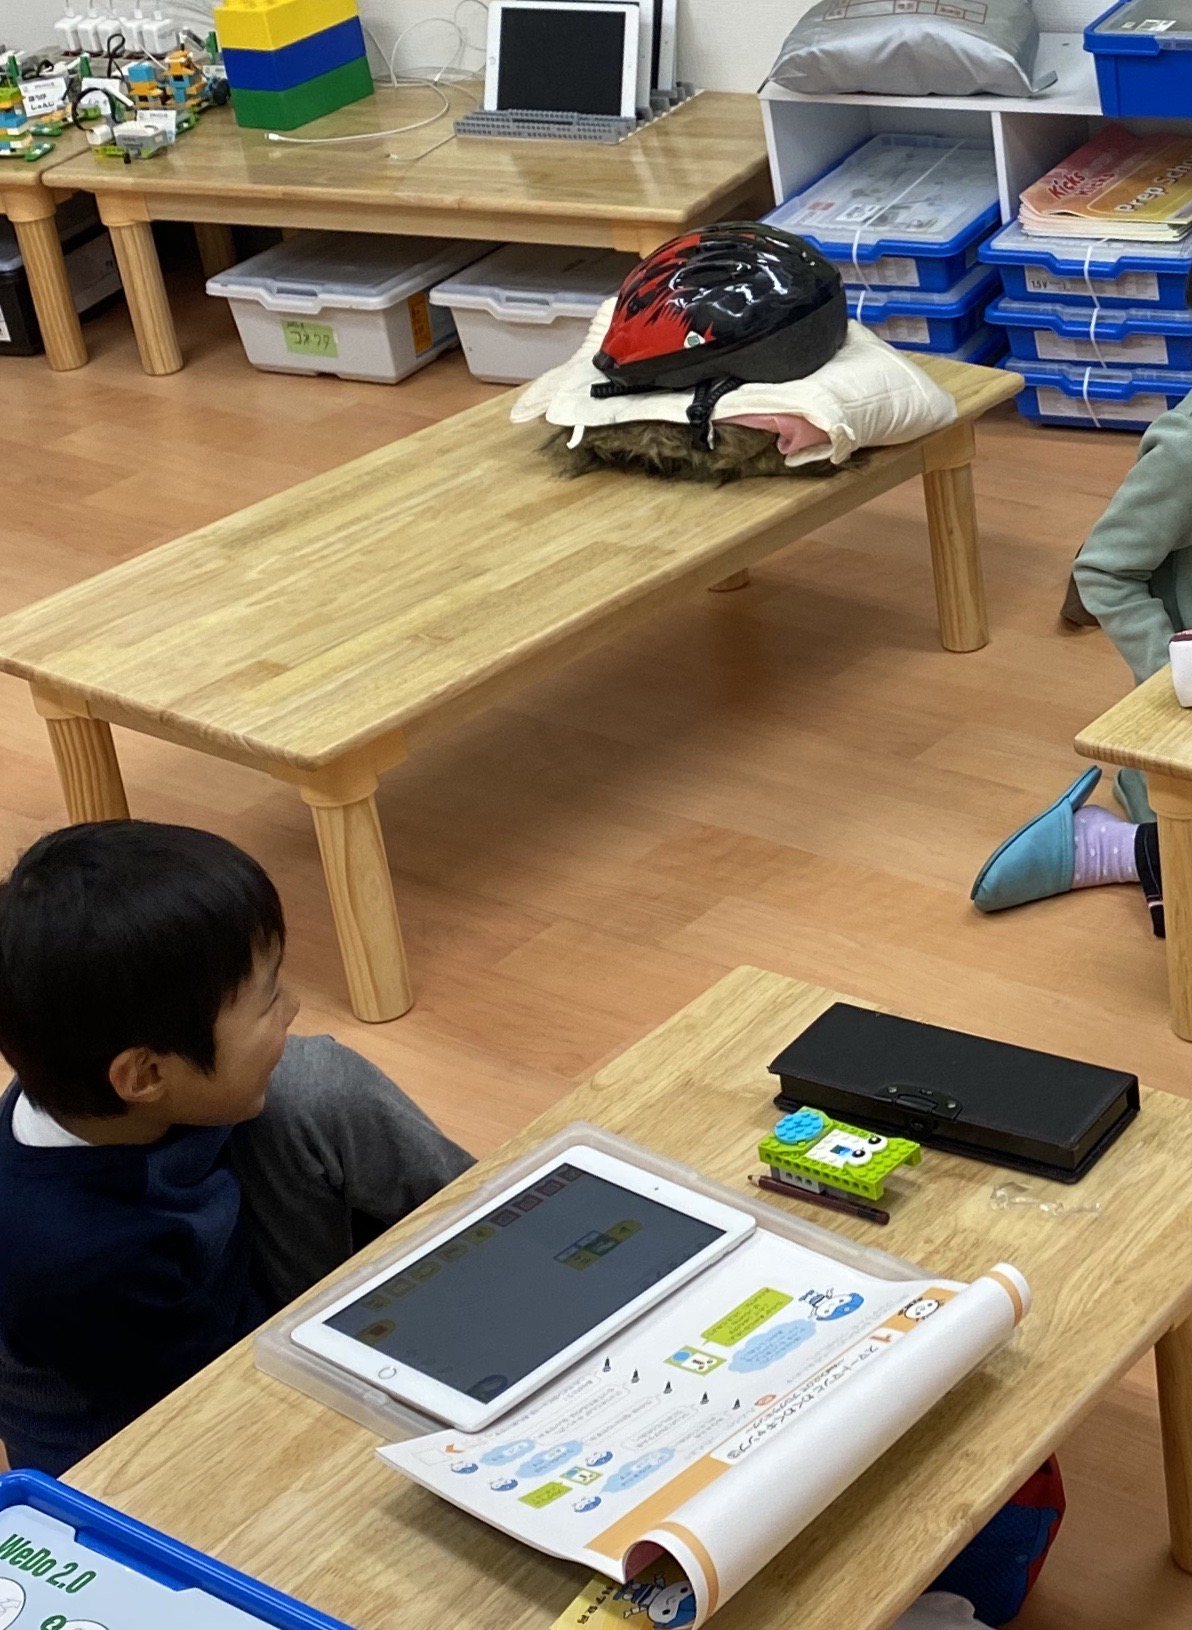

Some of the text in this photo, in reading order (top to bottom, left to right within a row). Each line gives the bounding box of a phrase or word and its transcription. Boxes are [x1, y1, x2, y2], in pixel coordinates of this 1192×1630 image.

[1048, 171, 1086, 200] Kicks
[1114, 186, 1167, 213] Prep
[0, 1533, 97, 1594] WeDo 2.0
